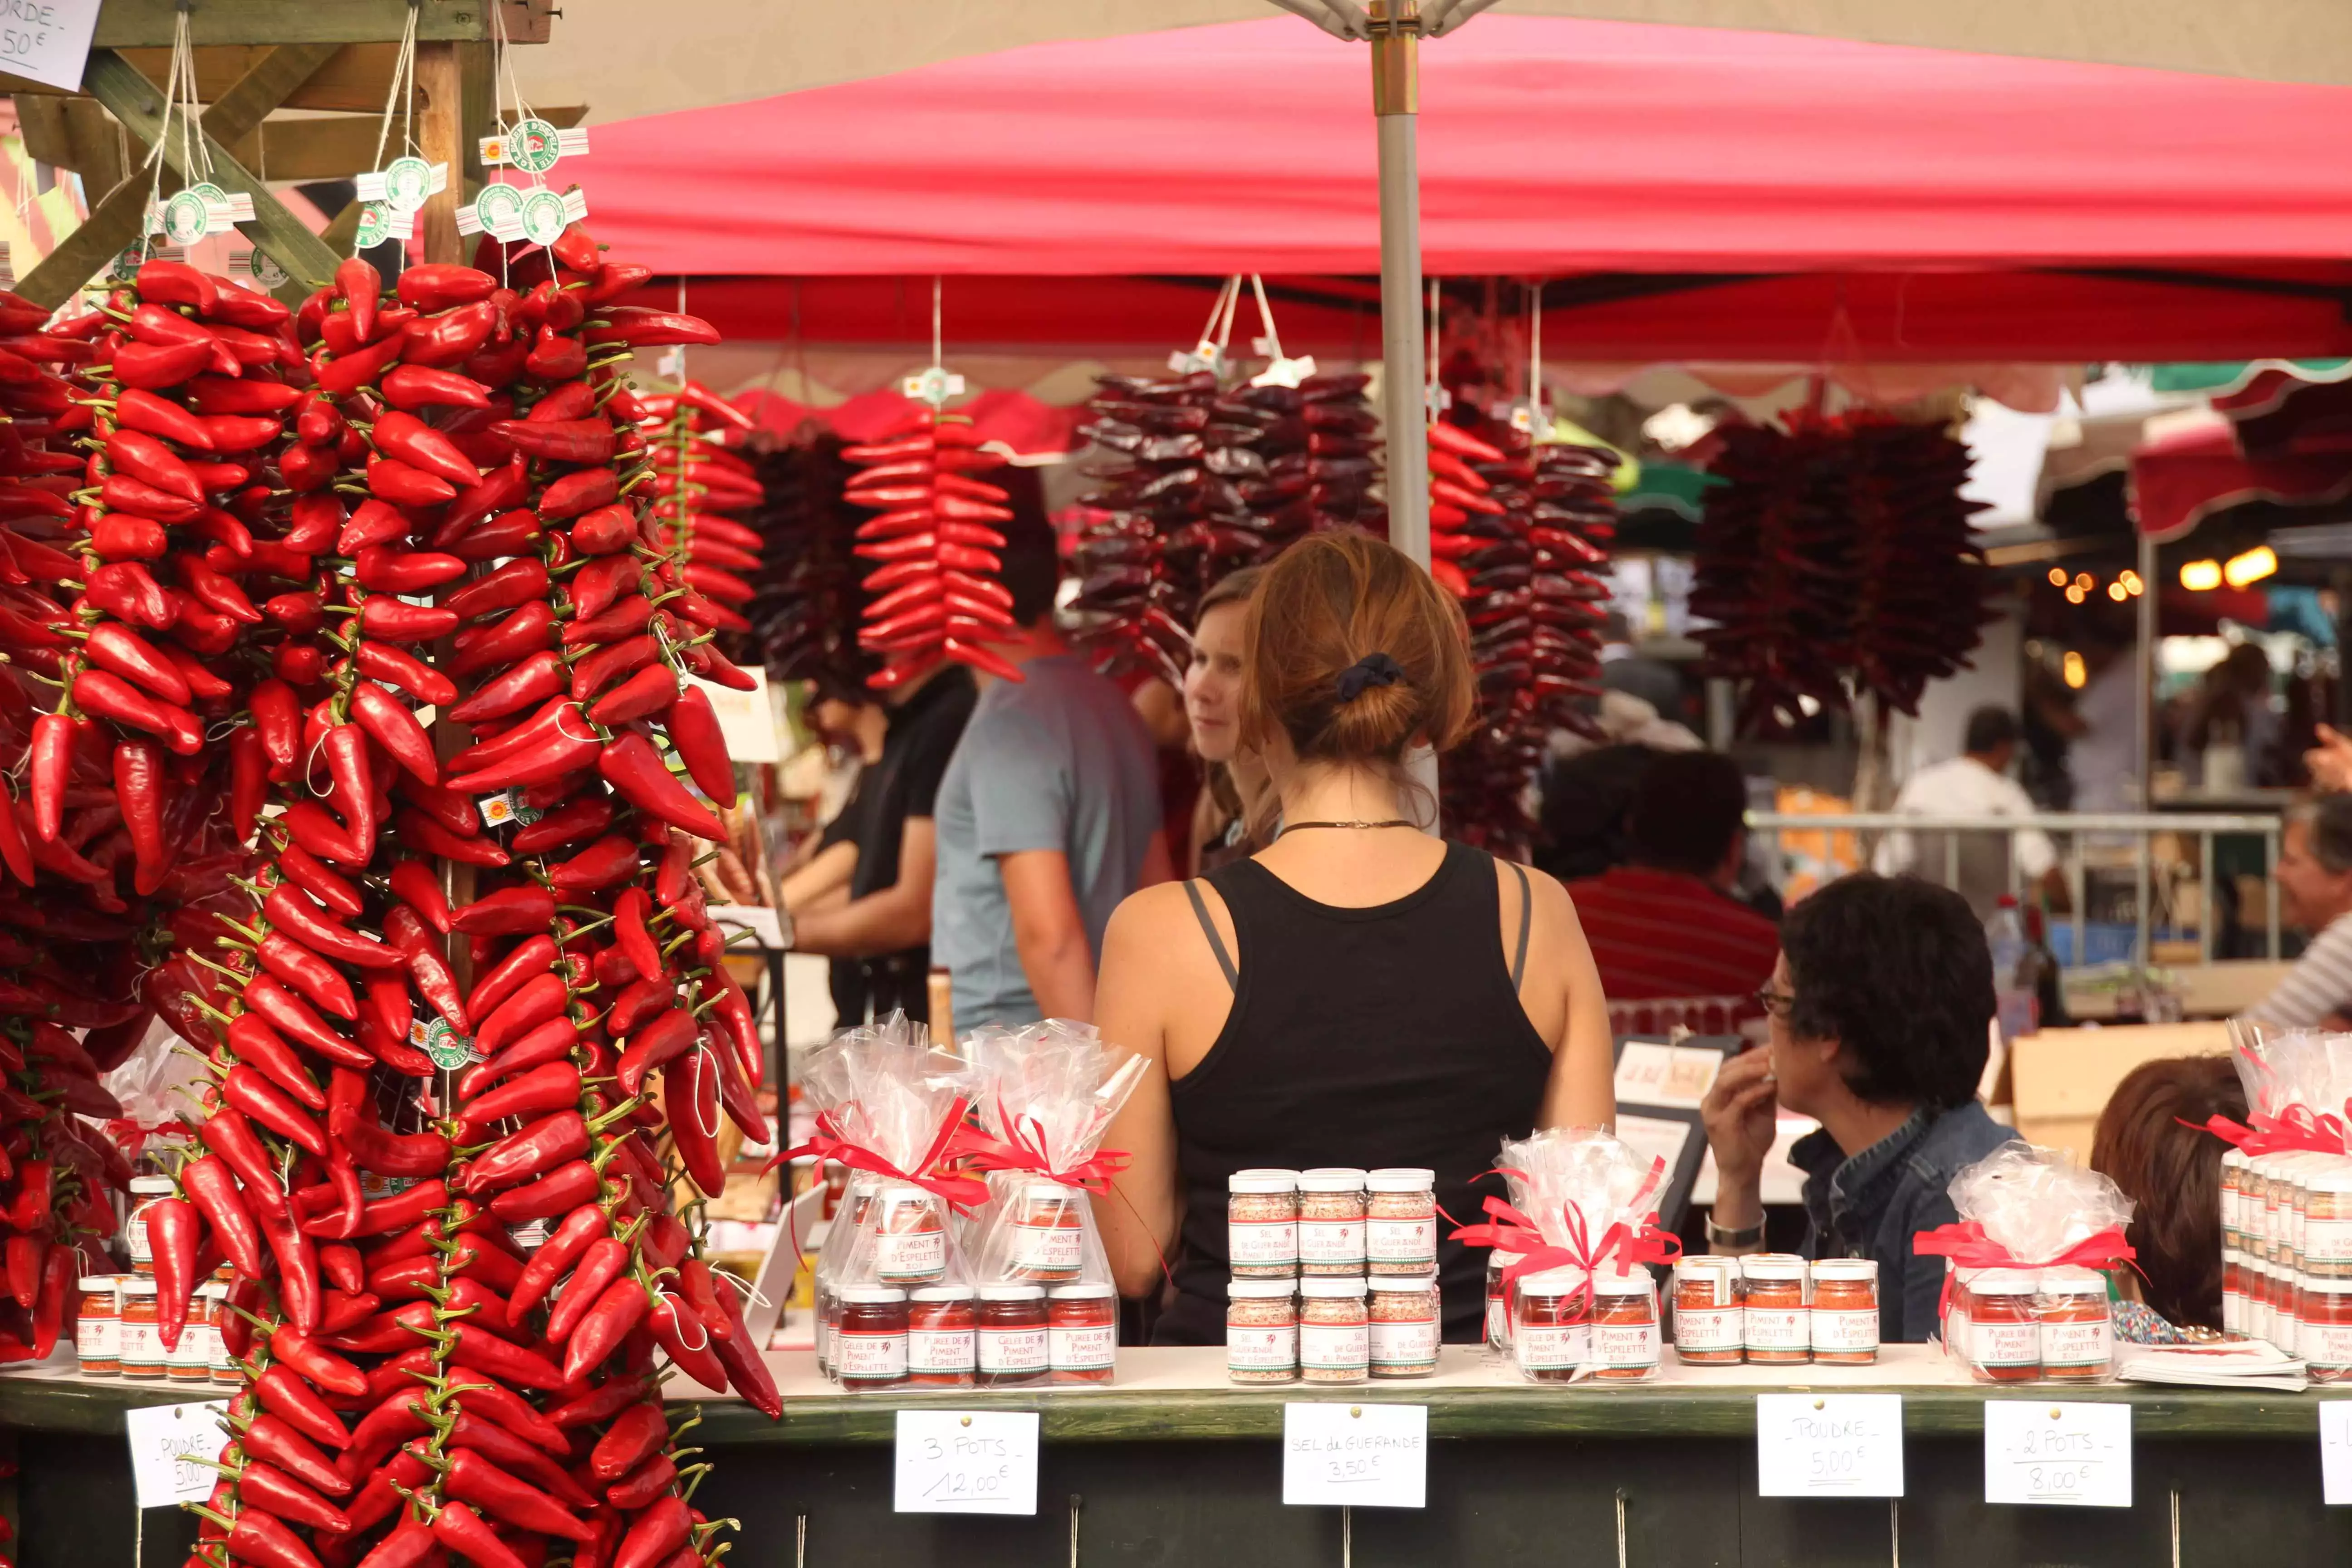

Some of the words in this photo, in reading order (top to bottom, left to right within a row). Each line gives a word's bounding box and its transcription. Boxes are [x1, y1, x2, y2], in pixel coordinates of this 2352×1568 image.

[1679, 1314, 1707, 1326] PIMENT
[1750, 1313, 1780, 1325] PIMENT
[953, 1336, 962, 1345] DE
[1093, 1333, 1103, 1341] DE
[1601, 1330, 1634, 1341] PIMENT
[867, 1342, 877, 1350] DE
[1003, 1346, 1034, 1355] PIMENT
[1071, 1343, 1102, 1352] PIMENT
[1792, 1417, 1865, 1439] POUDRE
[161, 1433, 205, 1459] POUDRE
[924, 1437, 943, 1460] 3
[954, 1436, 1007, 1456] POTS
[1291, 1438, 1323, 1452] SEL
[1345, 1435, 1421, 1450] GUERANDE
[2024, 1430, 2038, 1454] 2
[2044, 1430, 2093, 1452] POTS
[922, 1464, 1009, 1497] 12,00€
